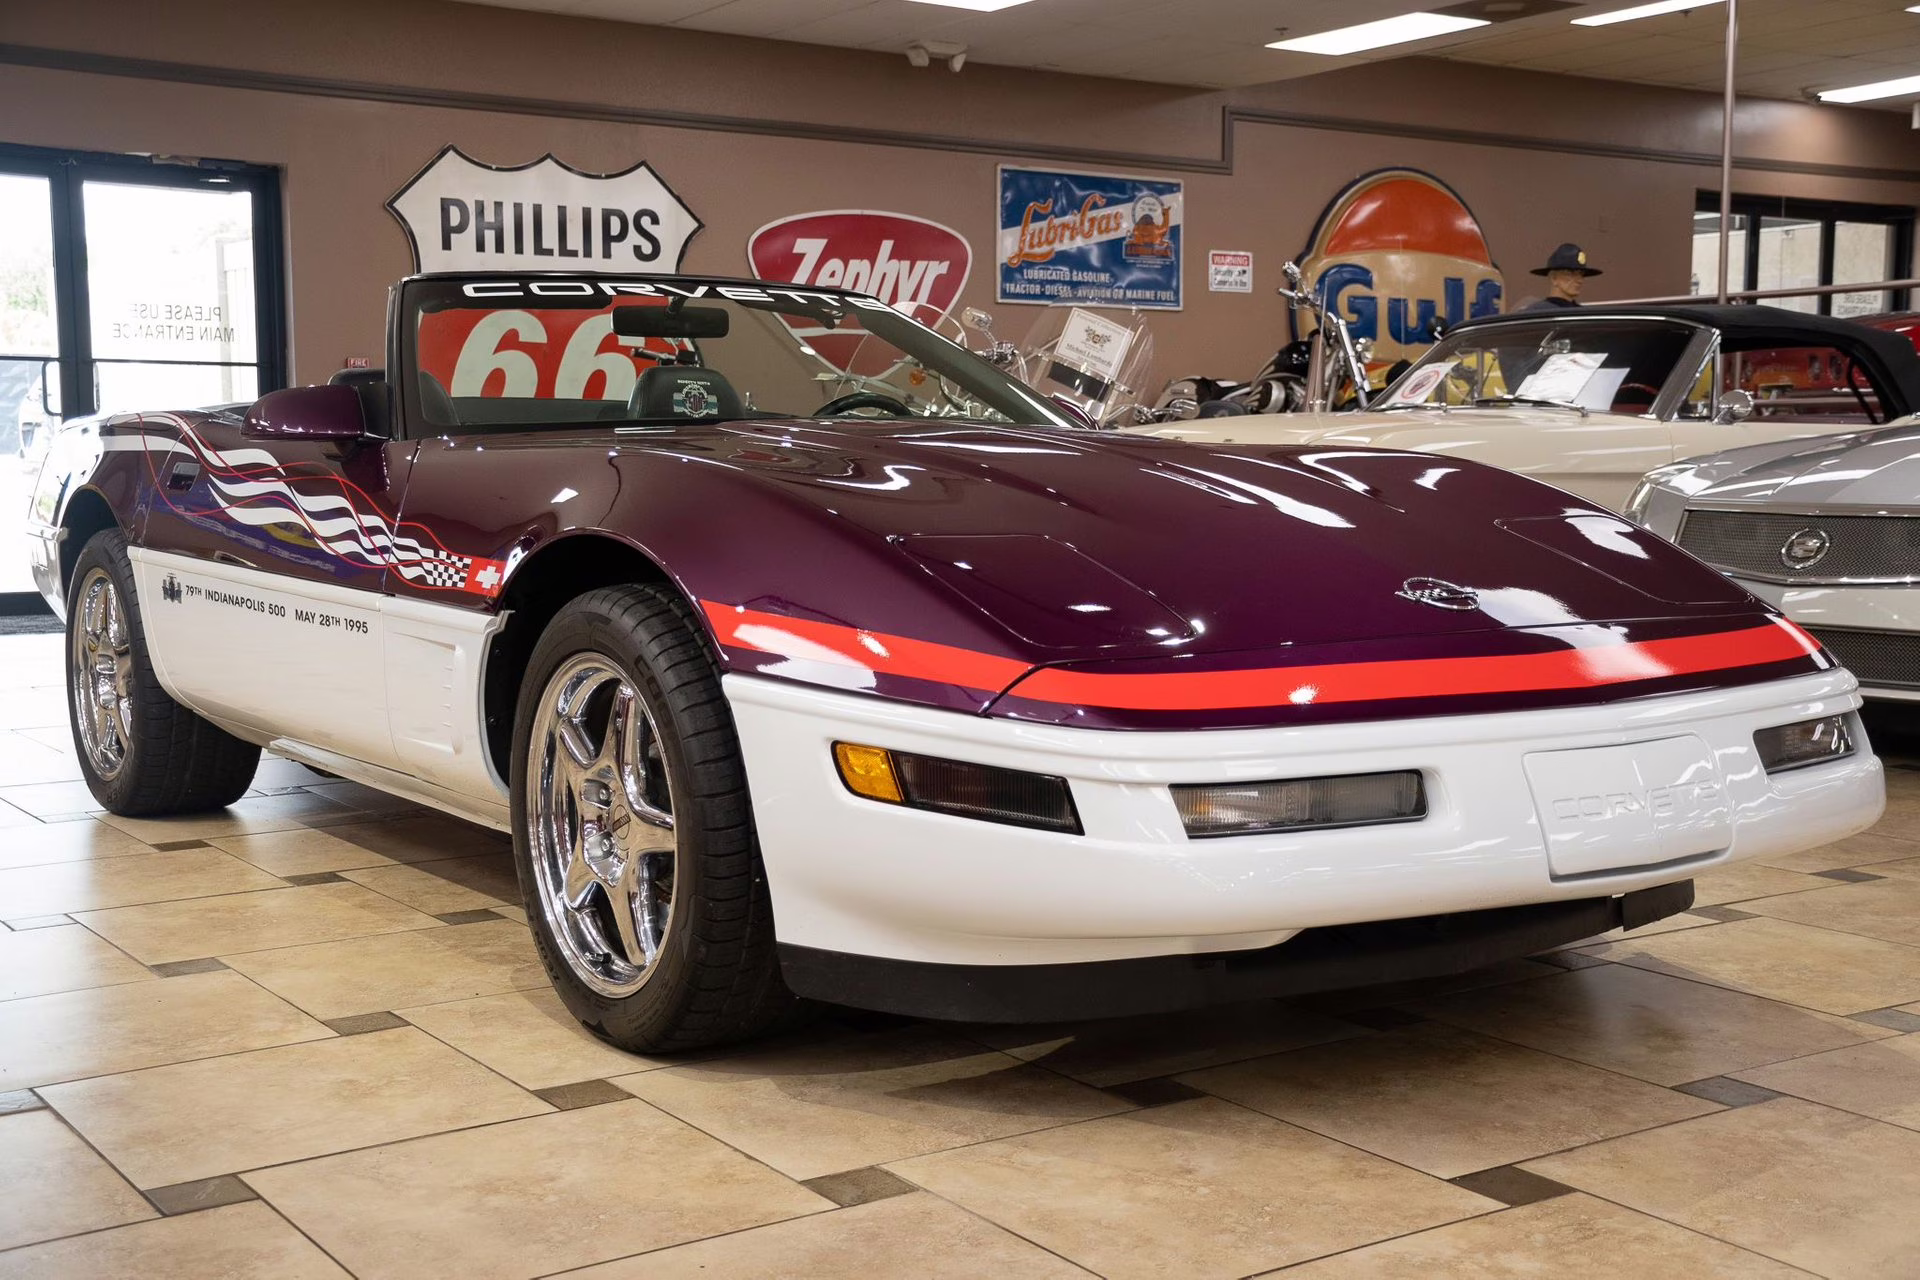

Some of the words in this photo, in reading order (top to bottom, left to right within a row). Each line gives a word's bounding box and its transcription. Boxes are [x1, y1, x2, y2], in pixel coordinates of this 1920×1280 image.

[440, 197, 661, 262] PHILLIPS
[1007, 193, 1123, 268] LubriGas
[790, 238, 950, 319] Zephyr
[1023, 269, 1071, 281] LUBRICATED
[1072, 271, 1110, 284] GASOLINE
[1213, 254, 1248, 266] WARNING
[462, 282, 895, 313] CORVETTE
[1006, 283, 1041, 295] TRACTOR
[1126, 289, 1156, 301] MARINE
[1157, 290, 1175, 302] FUEL
[1314, 263, 1502, 345] Gulf
[450, 309, 646, 401] 66
[185, 585, 202, 596] 79TH
[204, 589, 265, 613] INDIANAPOLIS
[268, 604, 286, 618] 500
[295, 609, 316, 624] MAY
[319, 614, 341, 627] 28TH
[344, 618, 368, 634] 1995
